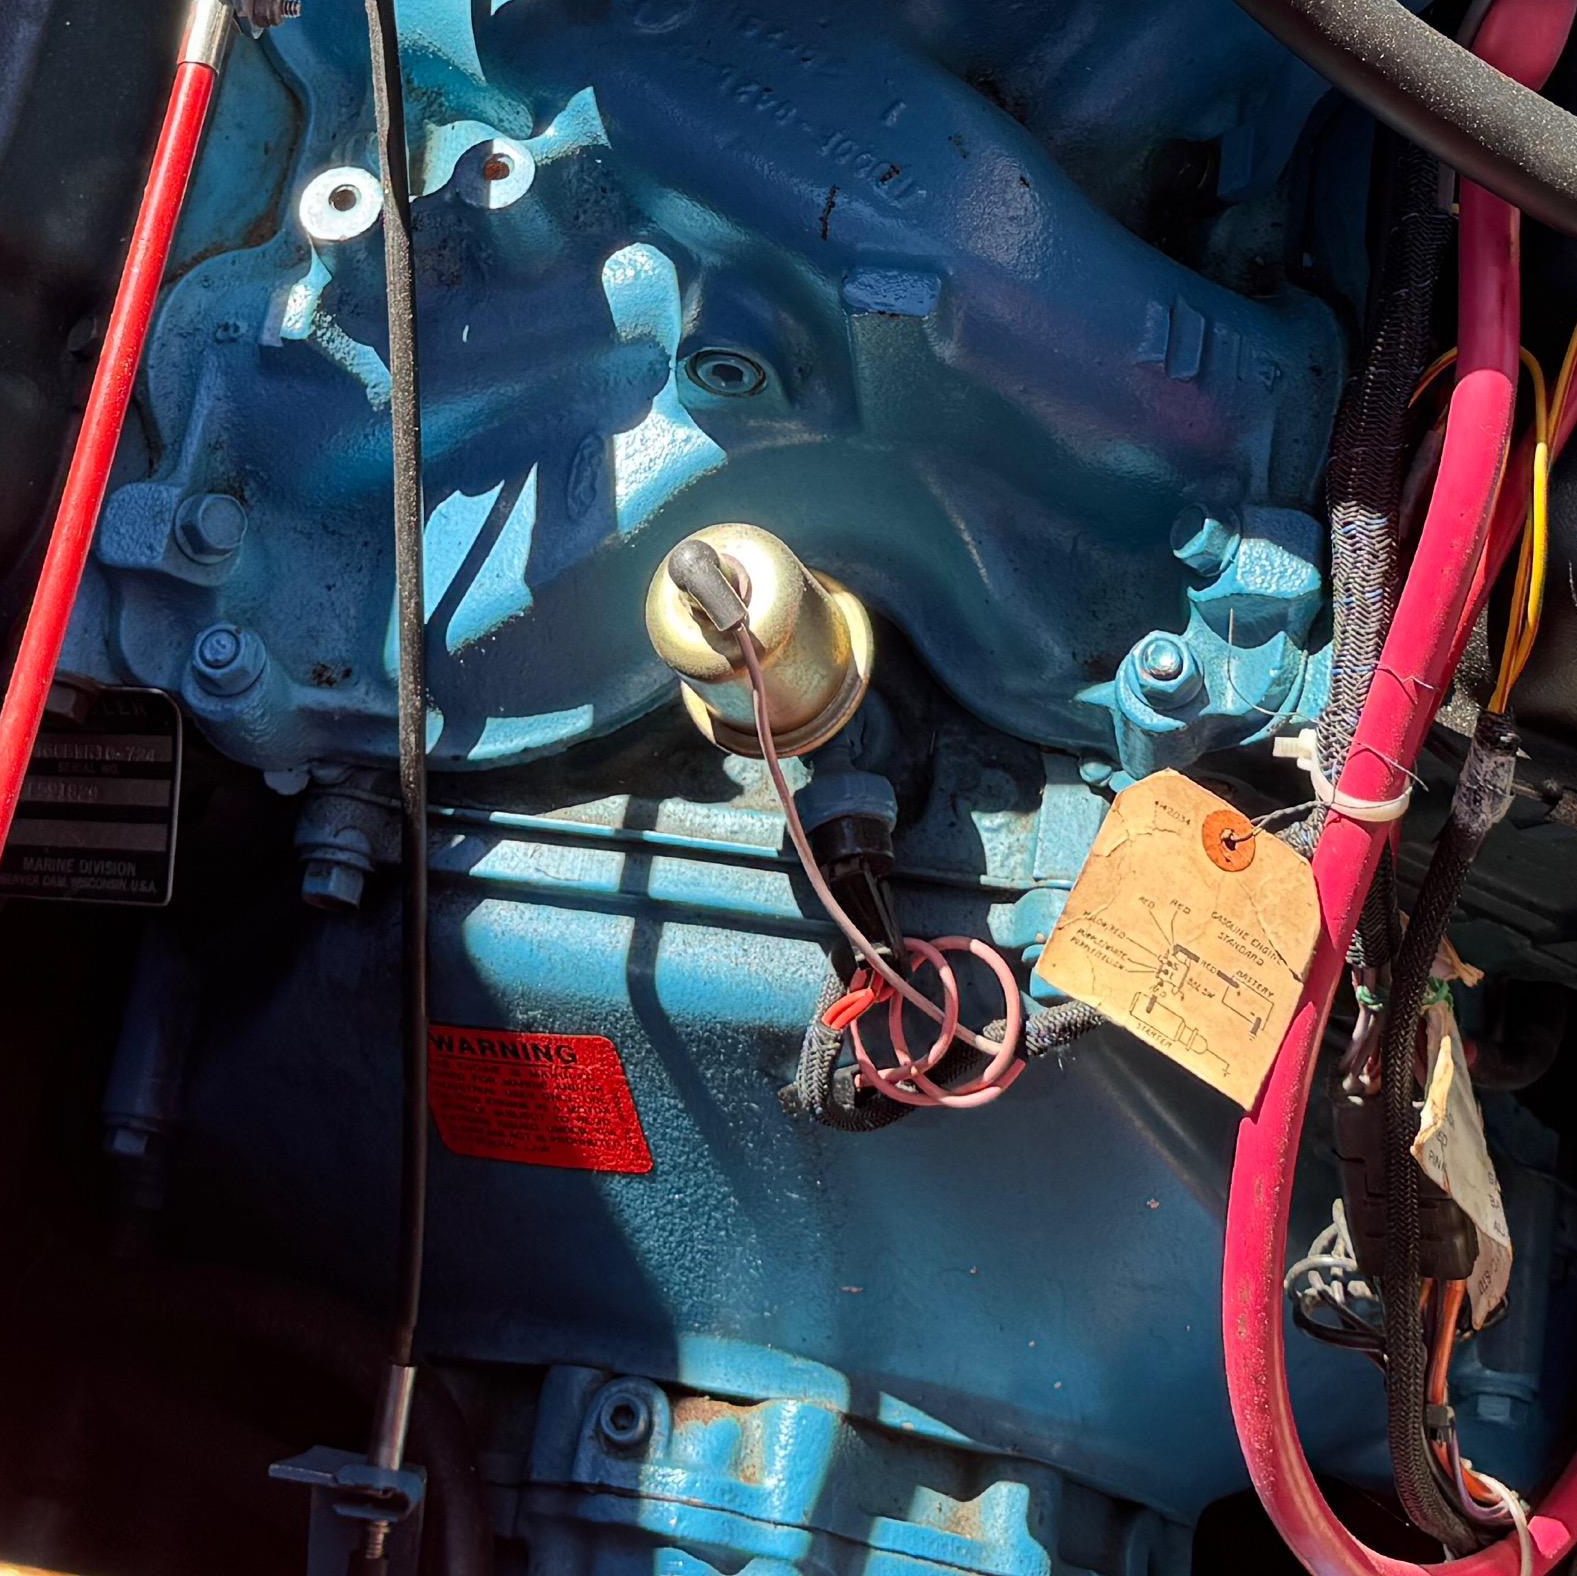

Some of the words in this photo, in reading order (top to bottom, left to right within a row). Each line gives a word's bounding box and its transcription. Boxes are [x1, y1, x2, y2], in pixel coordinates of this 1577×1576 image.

[23, 856, 76, 874] MARINE
[79, 859, 137, 877] DIVISION
[1211, 911, 1249, 946] GASOLINE
[1251, 937, 1285, 967] ENGINE
[1217, 933, 1265, 967] STANDARD
[1236, 969, 1276, 999] BATTERY
[428, 1033, 578, 1065] WARNING
